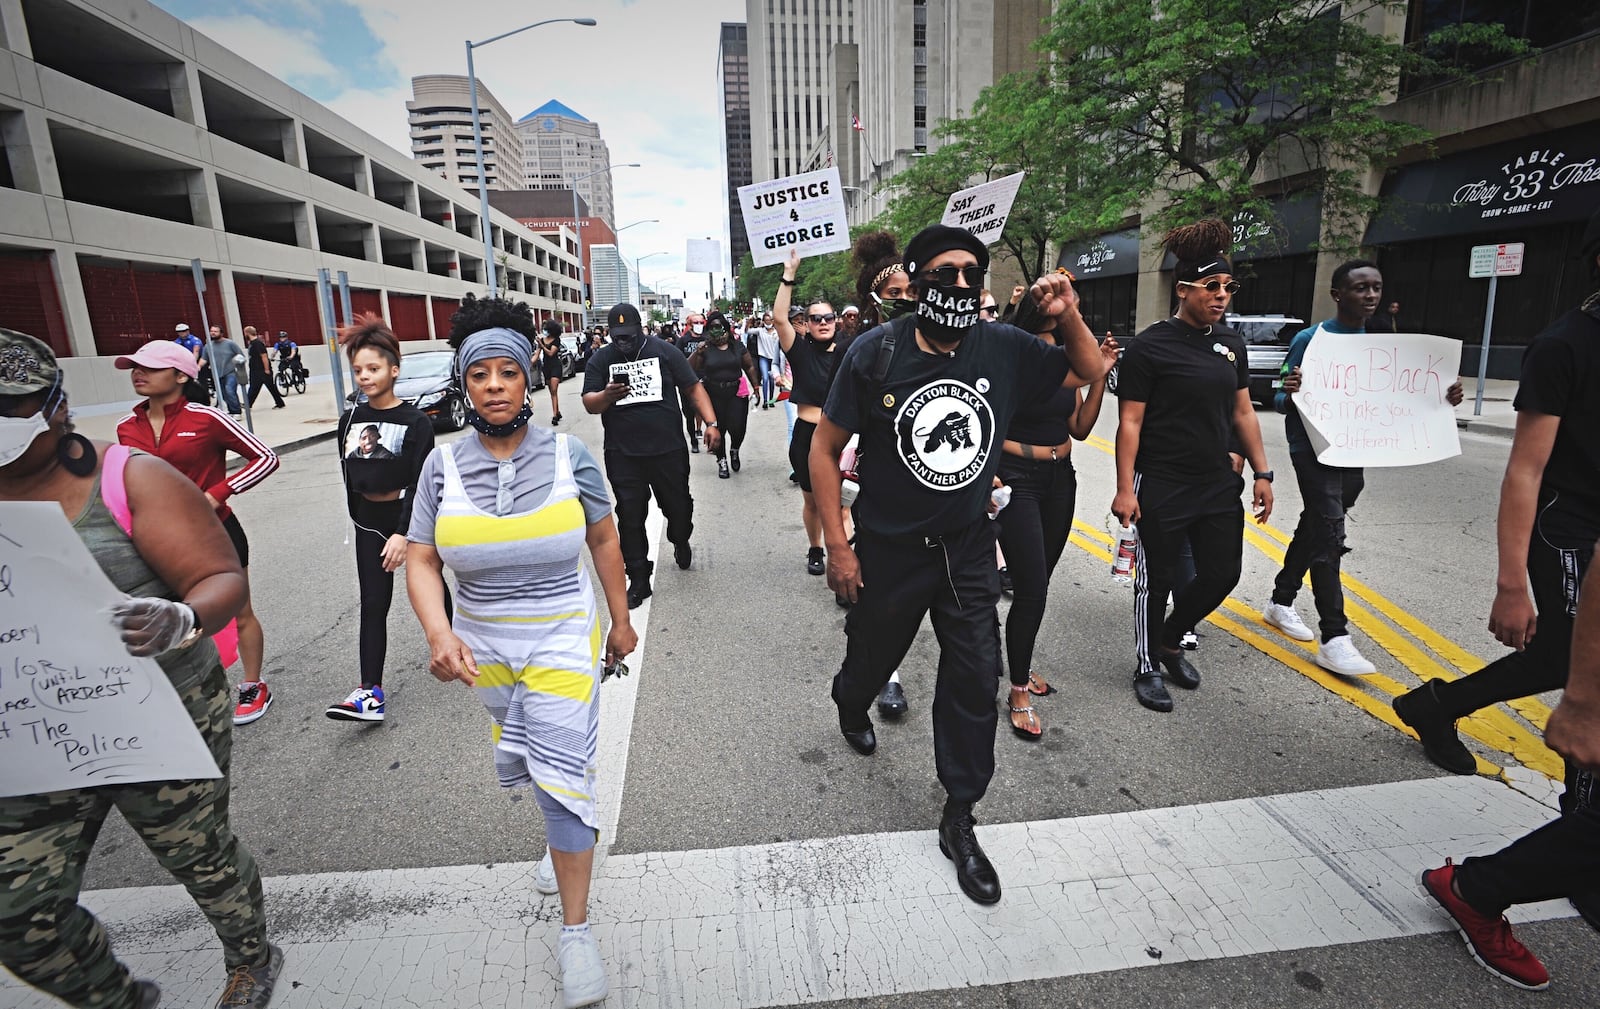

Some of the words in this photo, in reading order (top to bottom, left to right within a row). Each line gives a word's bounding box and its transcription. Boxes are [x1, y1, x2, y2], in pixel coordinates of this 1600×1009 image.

[1501, 149, 1565, 175] TABLE
[753, 180, 830, 210] JUSTICE
[1450, 180, 1501, 207] Thirty
[1502, 169, 1545, 202] 33
[1549, 158, 1600, 190] Thre
[789, 208, 800, 222] 4
[951, 195, 977, 213] SAY
[959, 204, 996, 225] THEIR
[1507, 203, 1532, 214] SHARE
[1537, 200, 1554, 210] EAT
[764, 222, 836, 250] GEORGE
[967, 216, 1006, 236] NAMES
[926, 288, 977, 312] BLACK
[917, 302, 979, 328] PANTHER
[611, 360, 655, 374] PROTECT
[1359, 347, 1444, 405] Black
[905, 385, 948, 418] DAYTON
[950, 386, 984, 411] BLACK
[907, 452, 957, 485] PANTHER
[958, 448, 986, 481] PARTY
[21, 718, 72, 744] The
[54, 733, 143, 762] Police
